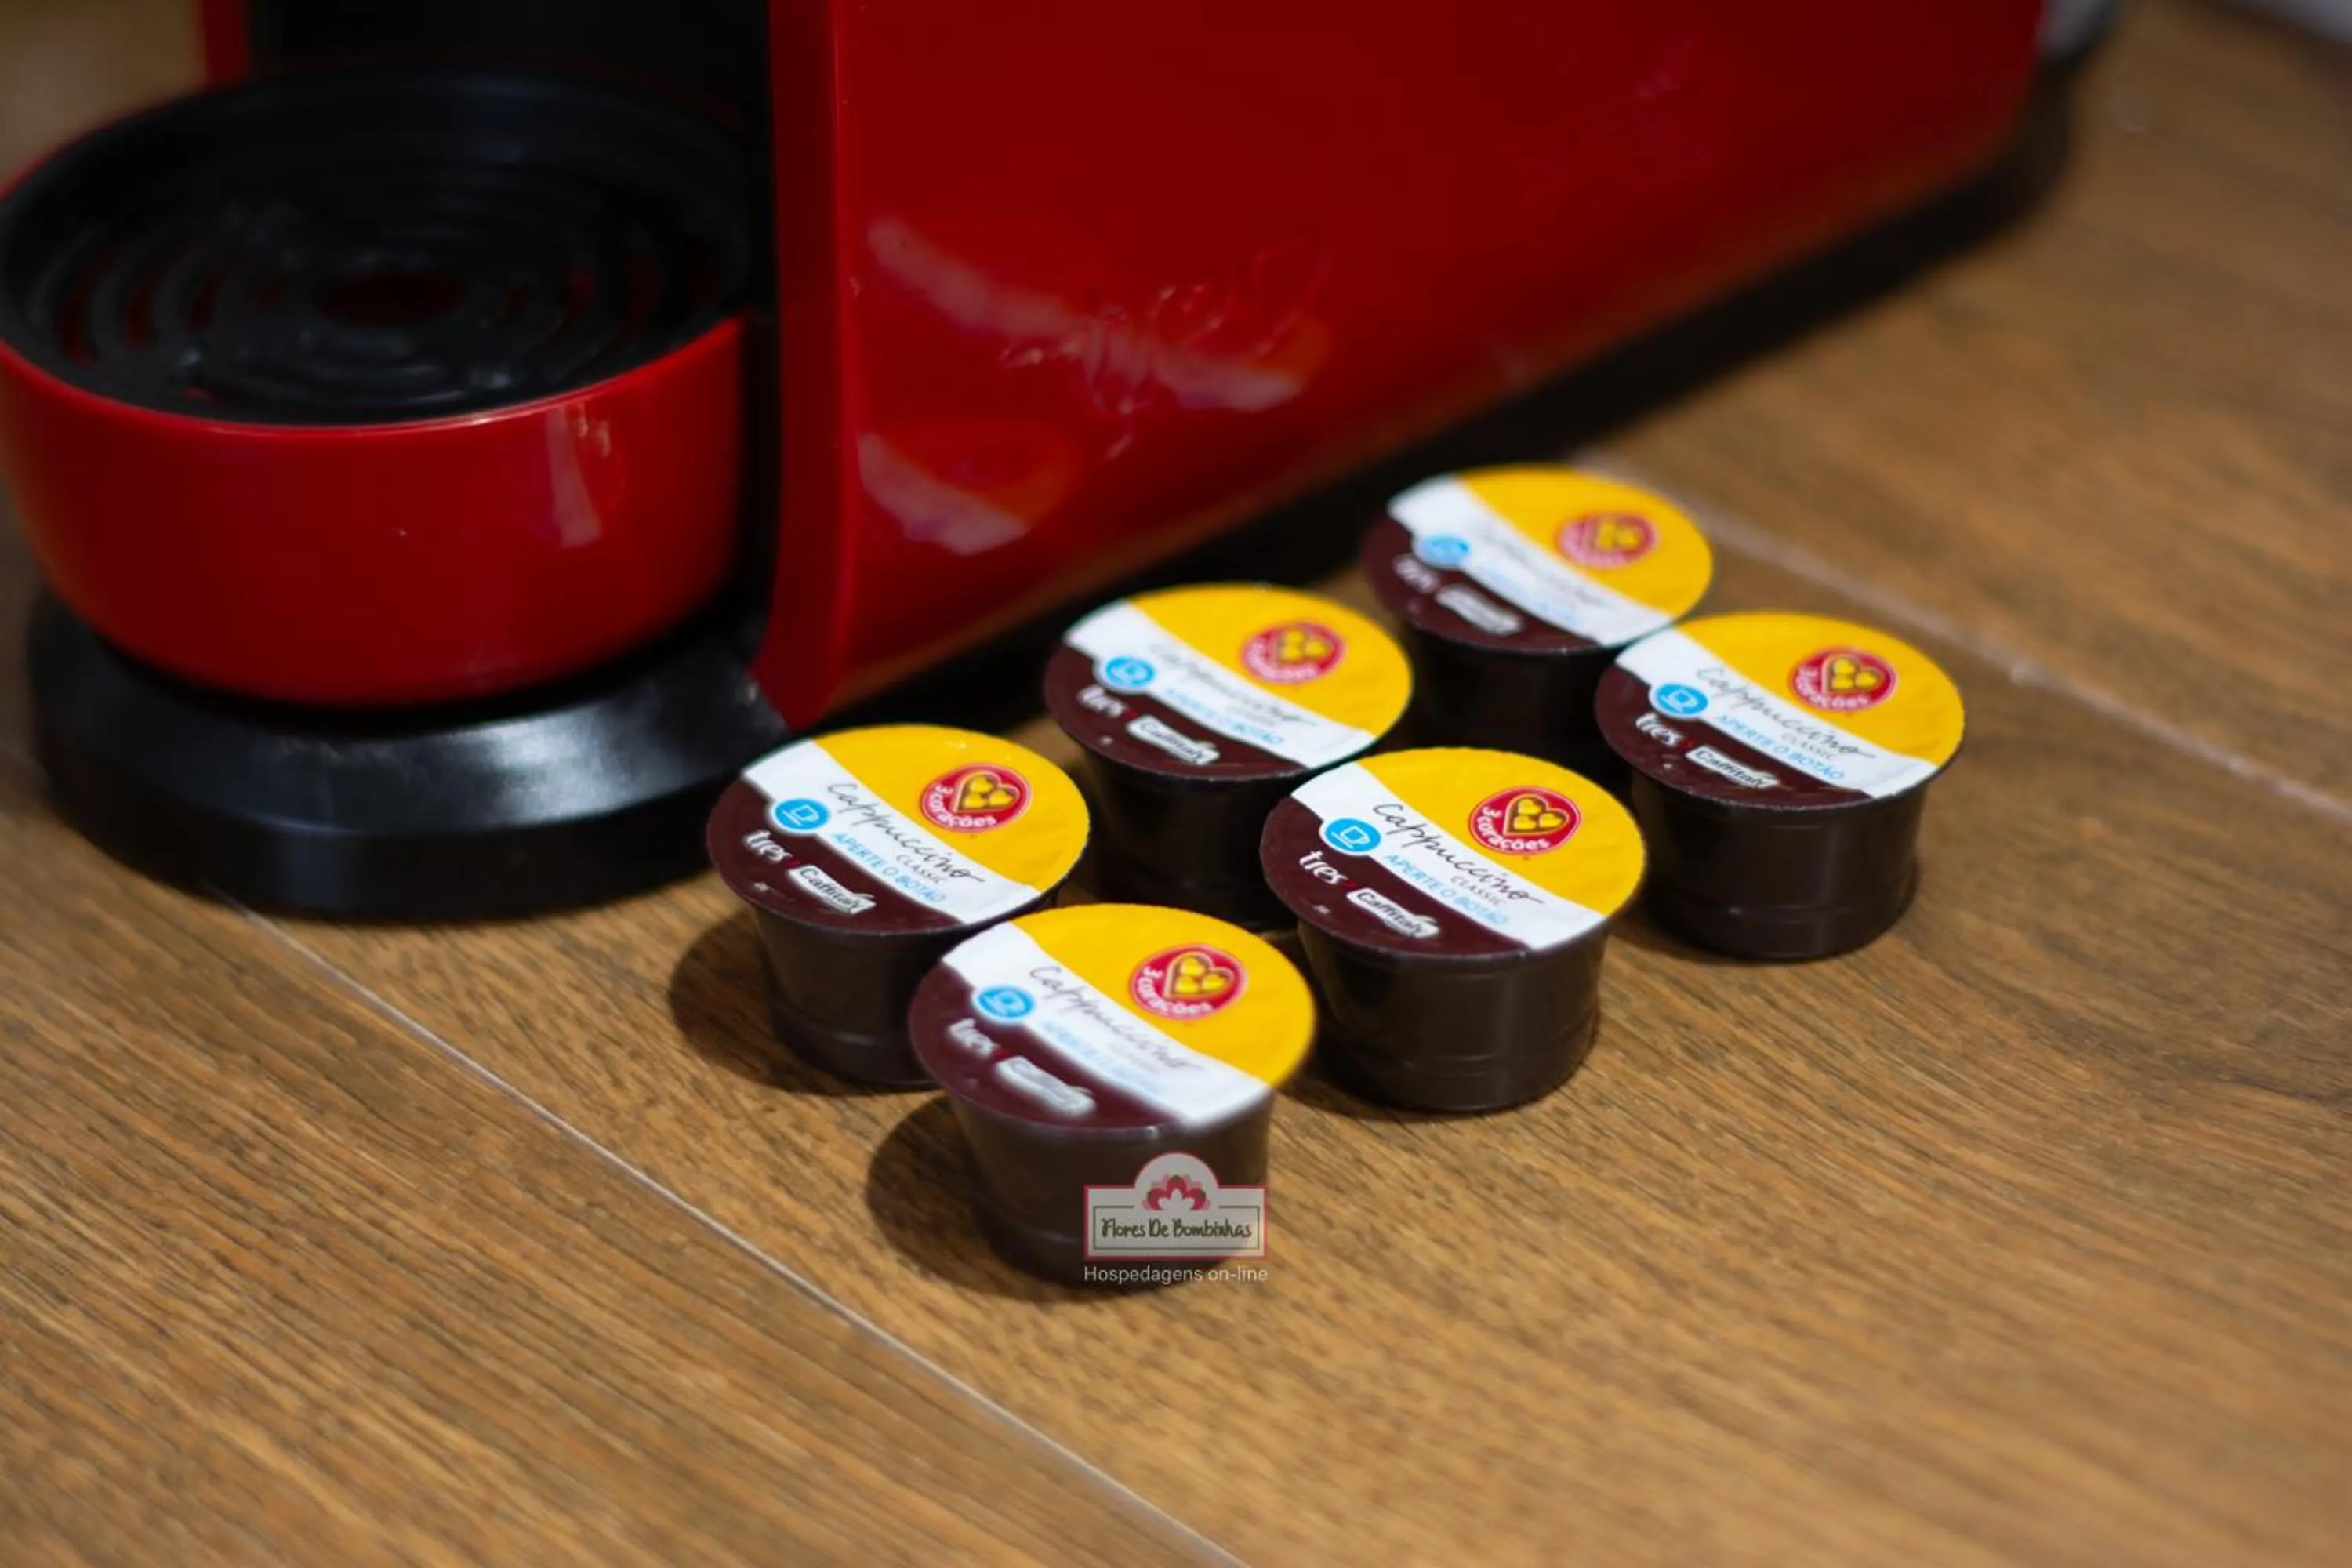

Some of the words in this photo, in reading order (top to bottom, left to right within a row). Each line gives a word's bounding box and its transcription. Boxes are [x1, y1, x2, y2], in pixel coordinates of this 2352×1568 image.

[1696, 668, 1876, 759] Cappuccino
[828, 784, 985, 882] Cappuccino
[831, 833, 887, 868] APERTE
[896, 854, 944, 884] CLASSIC
[1299, 851, 1348, 884] tres
[1373, 804, 1544, 903] Cappuccino
[1384, 854, 1444, 891] APERTE
